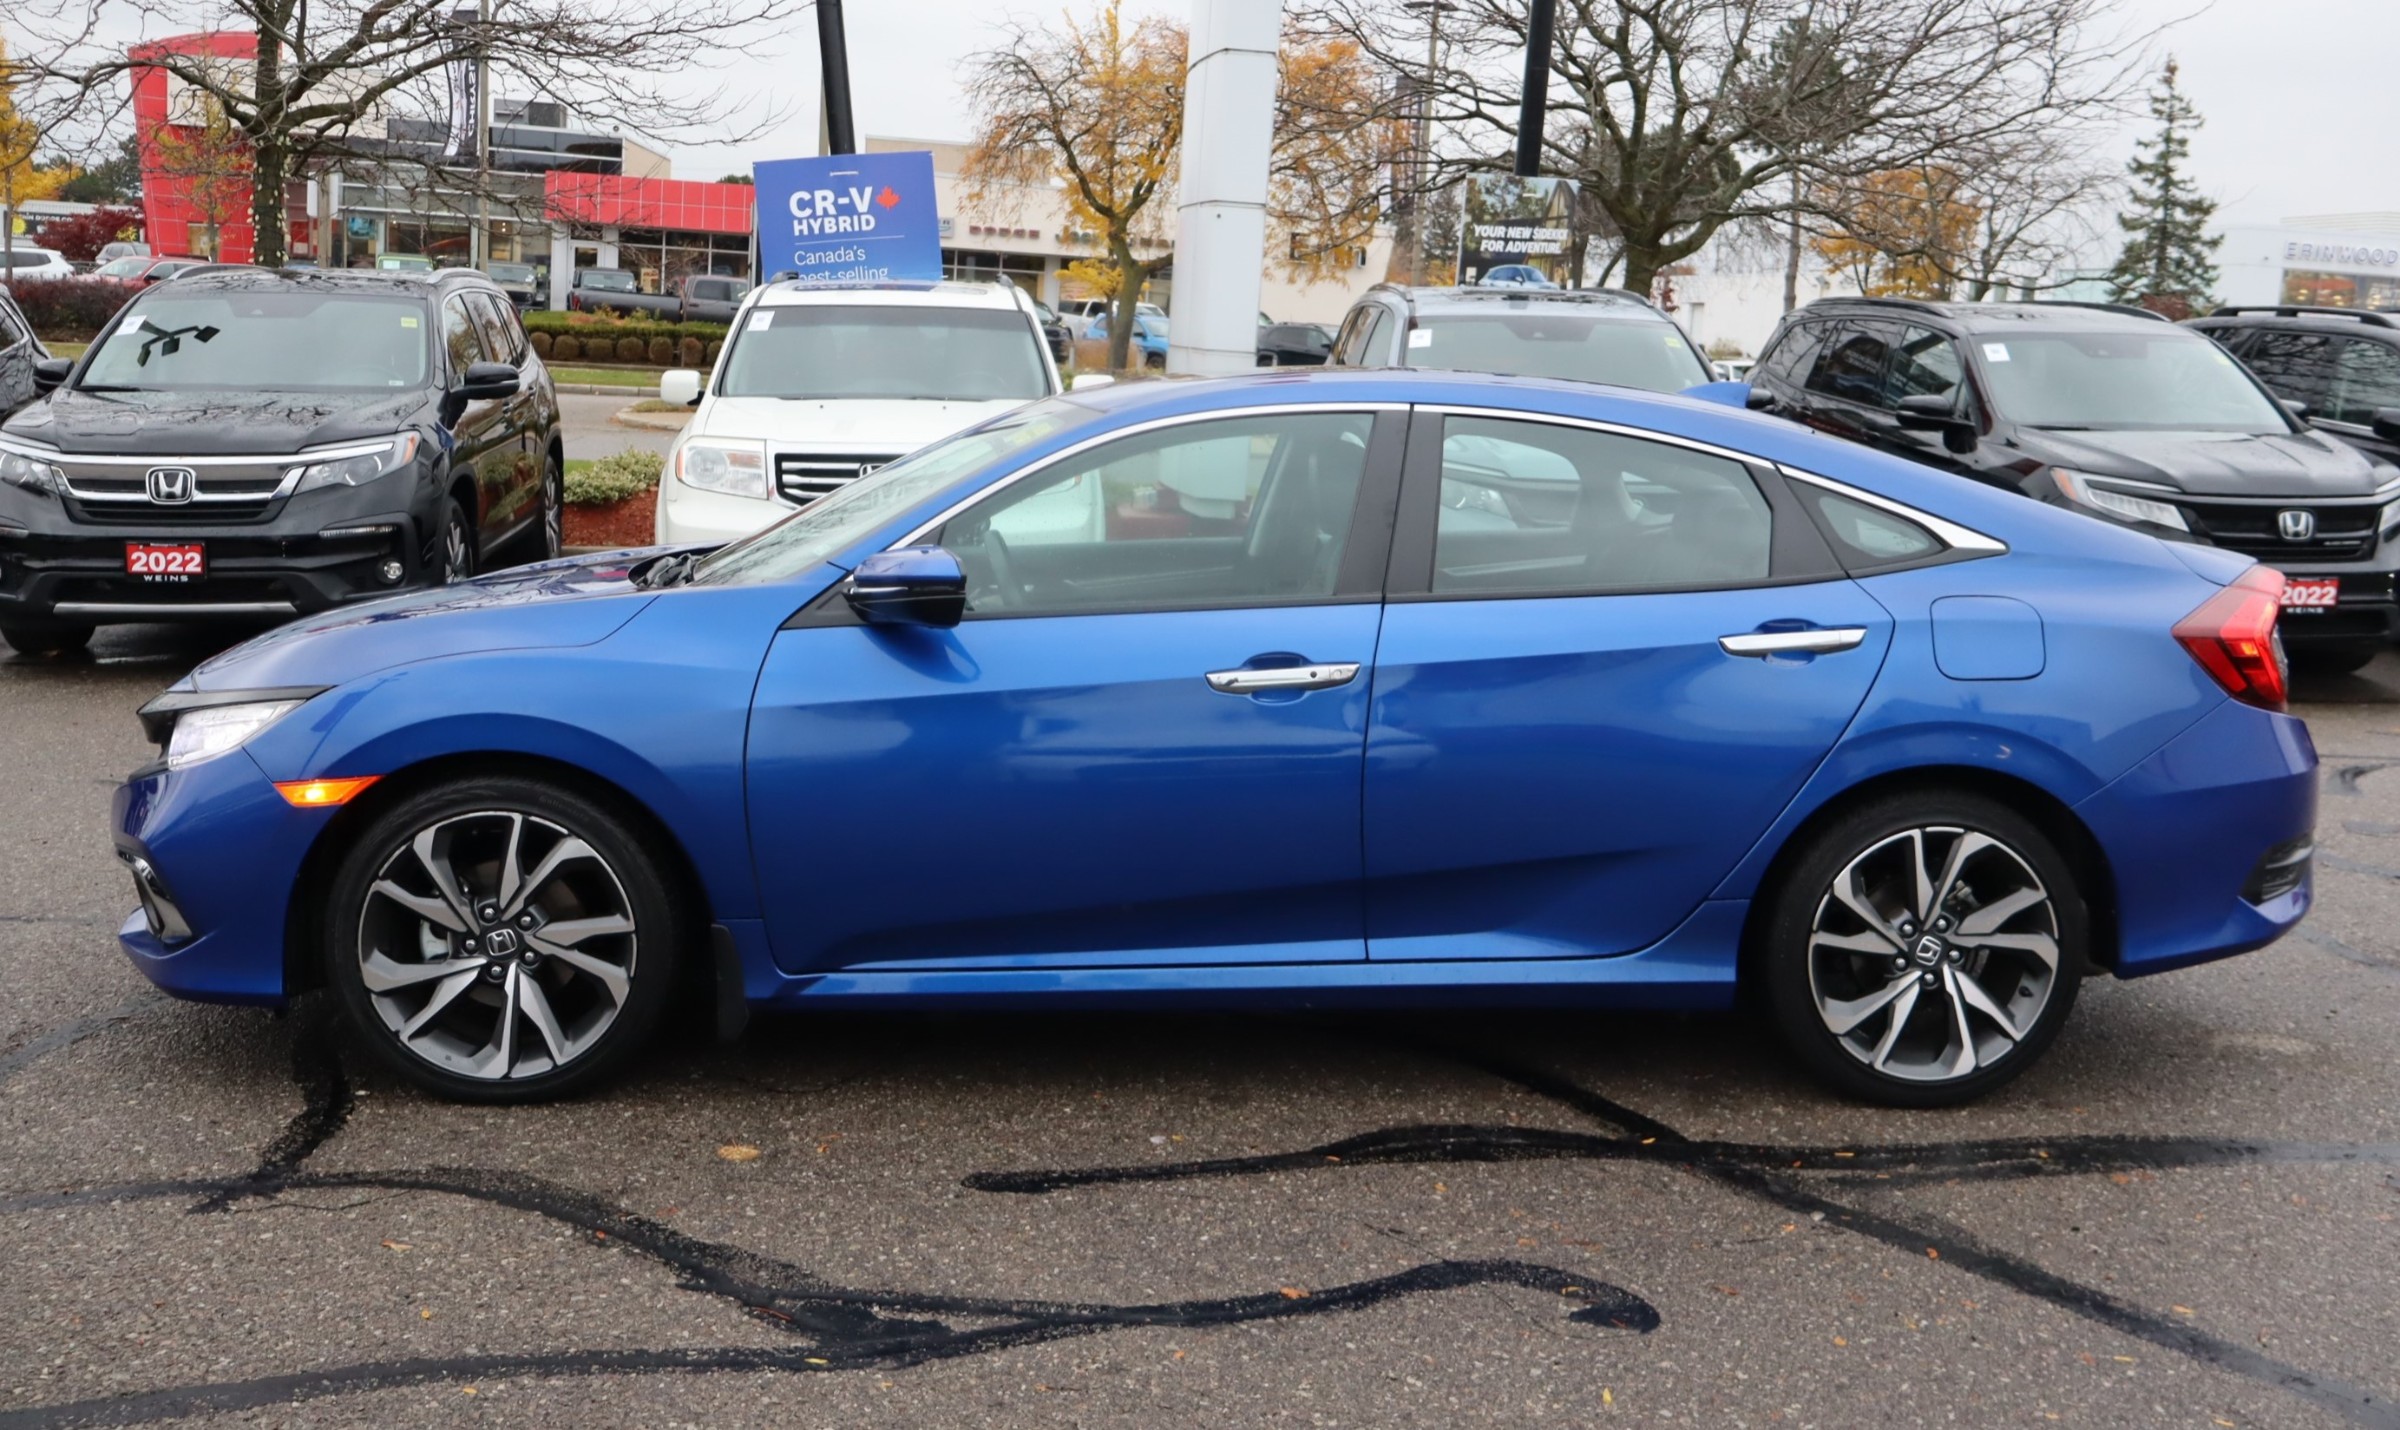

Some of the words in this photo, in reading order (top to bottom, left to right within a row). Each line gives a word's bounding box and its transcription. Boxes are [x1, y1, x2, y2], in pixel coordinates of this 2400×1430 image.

[789, 186, 873, 218] CR-V
[793, 214, 876, 236] HYBRID
[1474, 224, 1506, 238] YOUR
[1506, 226, 1533, 239] NEW
[1533, 227, 1568, 240] SIDEKICK
[794, 245, 866, 266] Canada's
[1480, 239, 1505, 252] FOR
[131, 551, 201, 572] 2022
[2280, 586, 2338, 605] 2022
